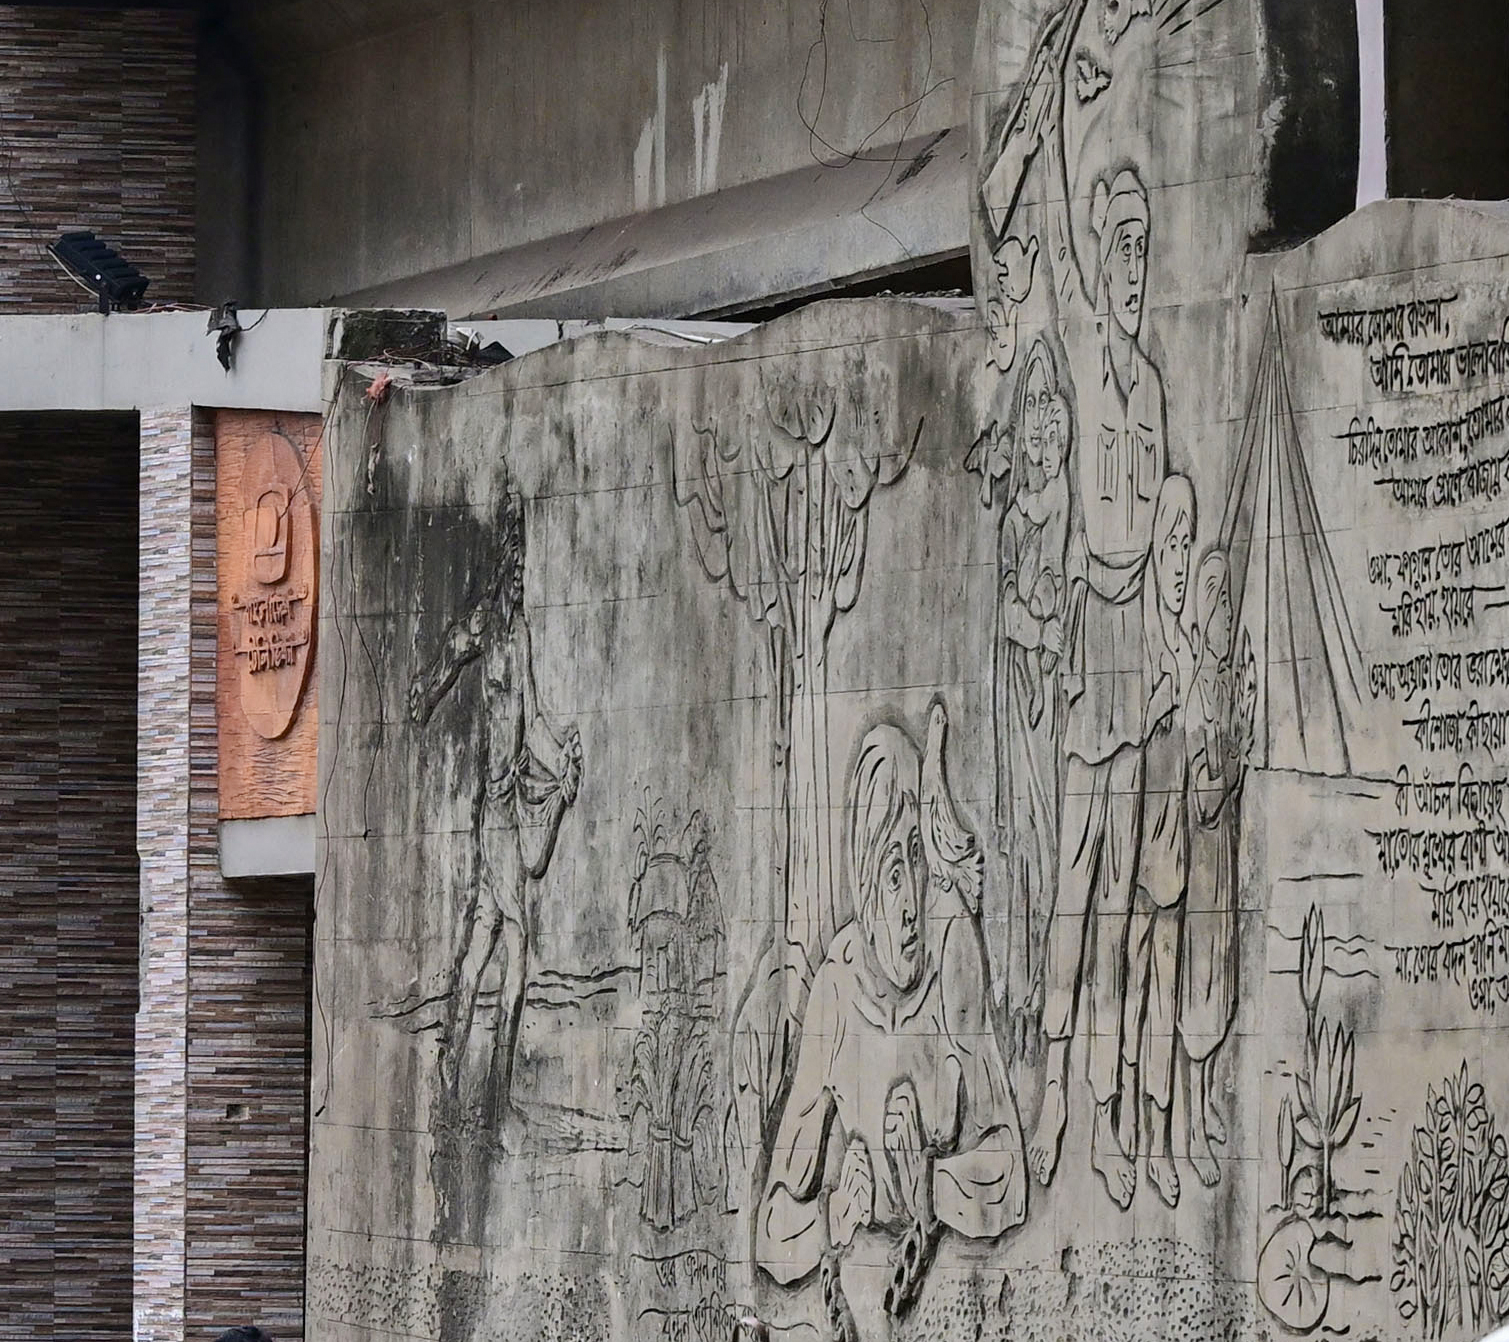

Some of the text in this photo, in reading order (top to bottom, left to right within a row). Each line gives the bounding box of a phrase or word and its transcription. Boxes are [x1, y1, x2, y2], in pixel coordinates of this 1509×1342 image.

[1318, 307, 1368, 346] আমার
[1370, 342, 1409, 392] আমি
[1383, 426, 1419, 464] তোমার
